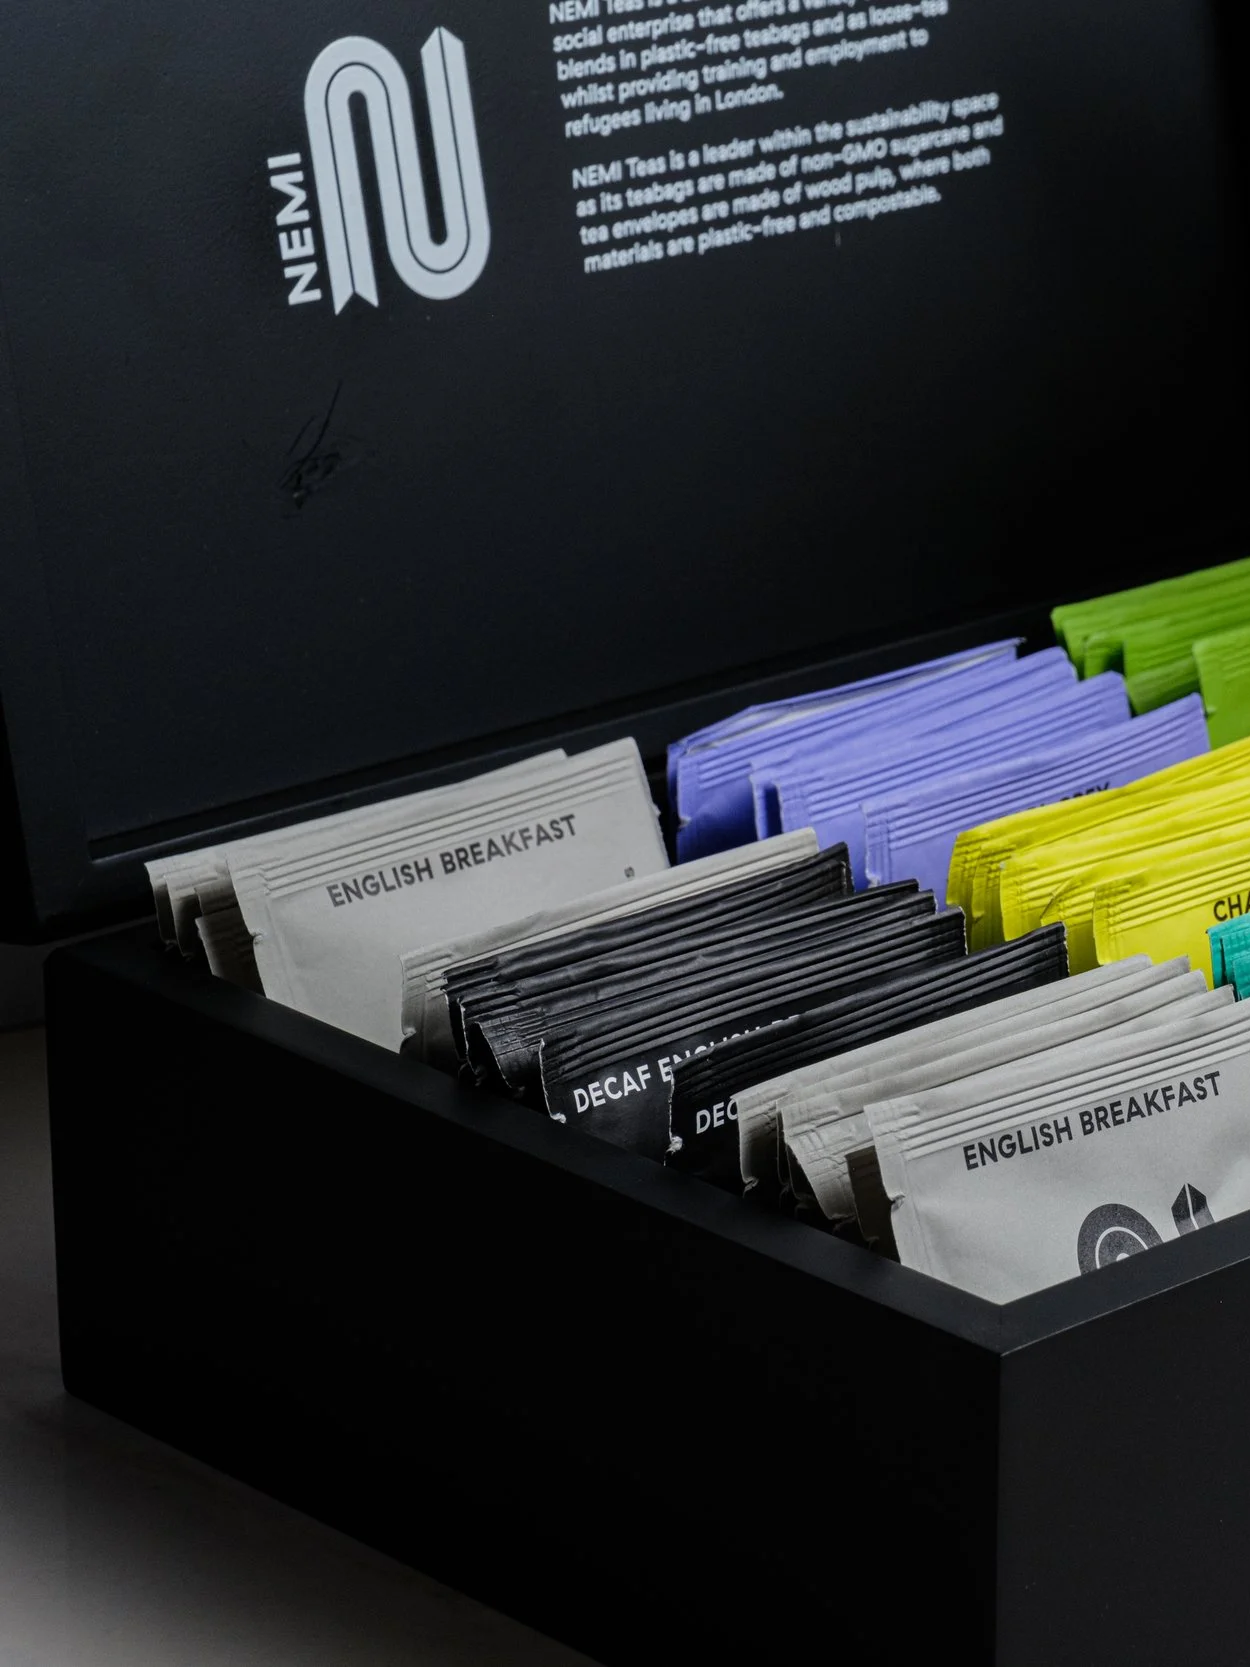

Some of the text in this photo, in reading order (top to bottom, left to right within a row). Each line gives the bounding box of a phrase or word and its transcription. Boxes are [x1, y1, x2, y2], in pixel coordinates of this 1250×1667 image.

[549, 0, 600, 24] NEMI
[553, 24, 603, 53] social
[606, 12, 695, 43] enterprise
[696, 4, 733, 28] that
[735, 0, 786, 21] offers
[557, 0, 948, 81] blends in plastic-free teabags and as loose-tea
[560, 28, 929, 109] whilst providing training and employment to
[565, 83, 784, 138] refugees living in London.
[572, 93, 999, 189] NEMI Teas is a leader within the sustainability space
[576, 115, 1003, 217] as its teabags are made of non-GMO sugarcane and
[267, 152, 322, 305] NEMI
[579, 225, 609, 245] tea
[612, 207, 699, 239] envelopes
[701, 201, 729, 221] are
[732, 188, 780, 214] made
[782, 181, 802, 205] of
[804, 172, 852, 200] wood
[899, 156, 950, 180] where
[952, 146, 990, 170] both
[584, 184, 941, 273] materials are plastic-free and compostable.
[326, 814, 576, 908] ENGLISH BREAKFAST
[573, 1064, 651, 1113] DECAF
[963, 1070, 1220, 1171] ENGLISH BREAKFAST
